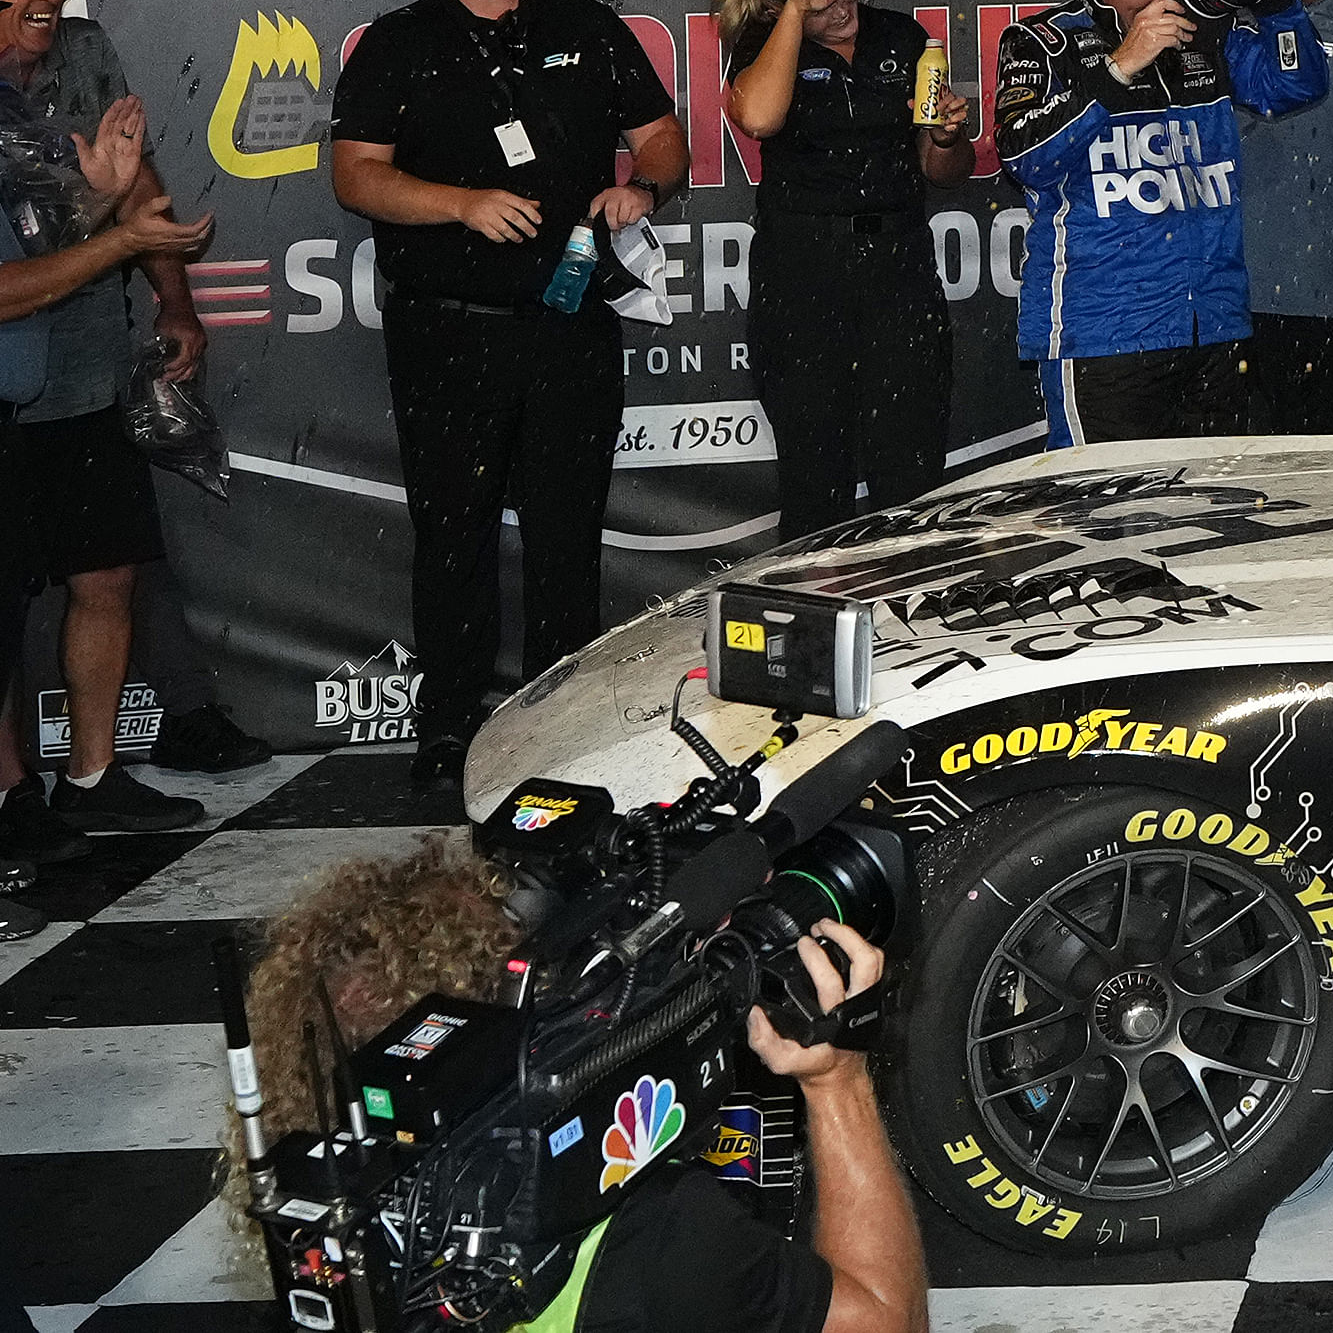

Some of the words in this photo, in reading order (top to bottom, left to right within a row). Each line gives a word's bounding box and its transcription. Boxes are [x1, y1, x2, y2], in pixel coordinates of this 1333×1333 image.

[1089, 120, 1202, 171] HIGH
[1091, 161, 1235, 218] POINT
[670, 415, 758, 450] 1950
[733, 625, 753, 645] 21
[315, 672, 424, 728] BUS
[699, 1048, 725, 1089] 21
[942, 1133, 1083, 1240] EAGLE
